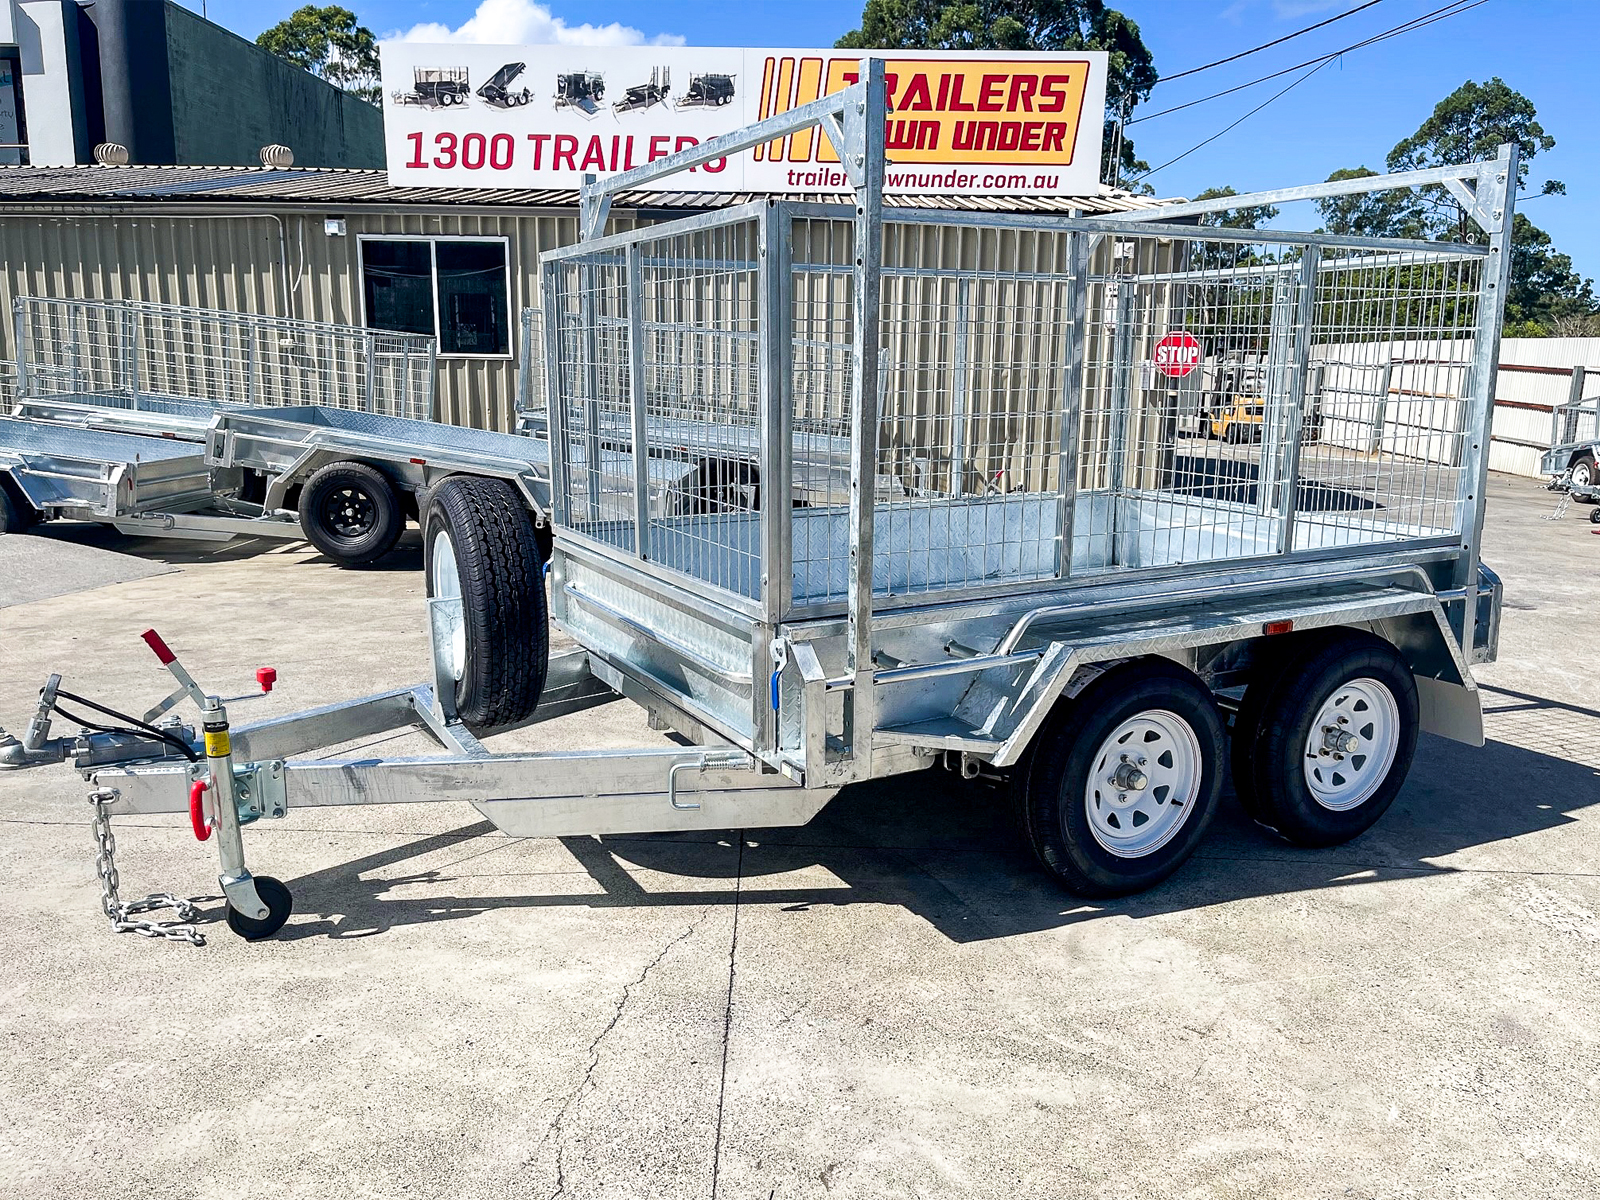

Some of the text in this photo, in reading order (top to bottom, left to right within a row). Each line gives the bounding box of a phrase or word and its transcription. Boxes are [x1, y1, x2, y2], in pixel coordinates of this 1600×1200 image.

[885, 119, 1068, 151] WN UNDER
[406, 131, 515, 170] 1300
[1157, 345, 1198, 363] STOP
[312, 469, 363, 491] LONGWAY
